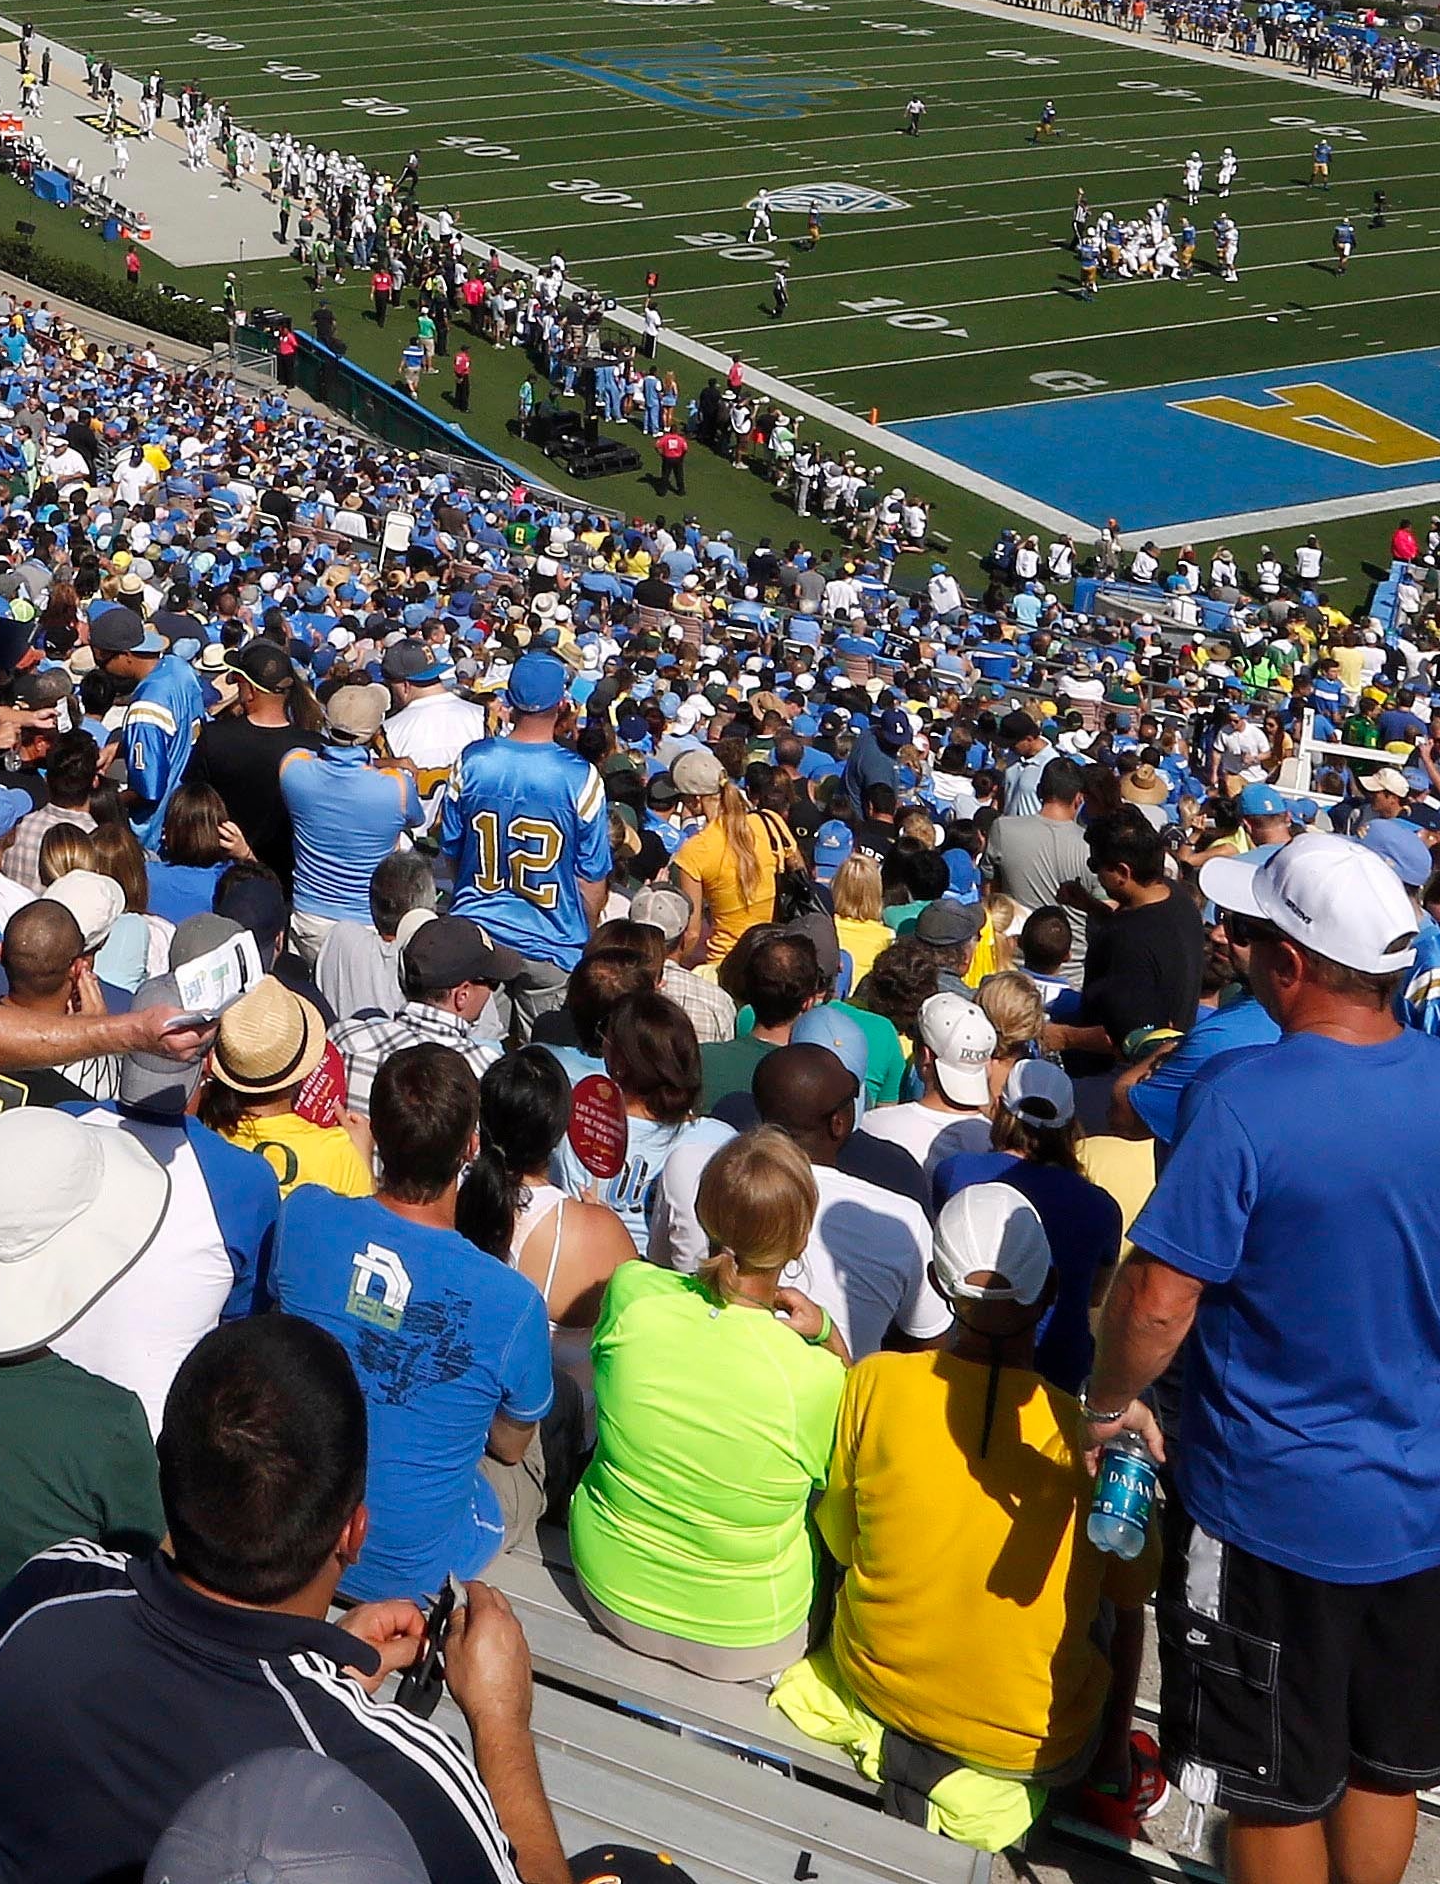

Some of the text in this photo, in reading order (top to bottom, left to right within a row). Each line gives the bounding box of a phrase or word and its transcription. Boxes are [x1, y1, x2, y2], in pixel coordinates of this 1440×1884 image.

[340, 97, 410, 117] 50
[837, 296, 951, 331] 10
[514, 526, 526, 545] 8
[471, 811, 564, 910] 12
[252, 1141, 298, 1186] O
